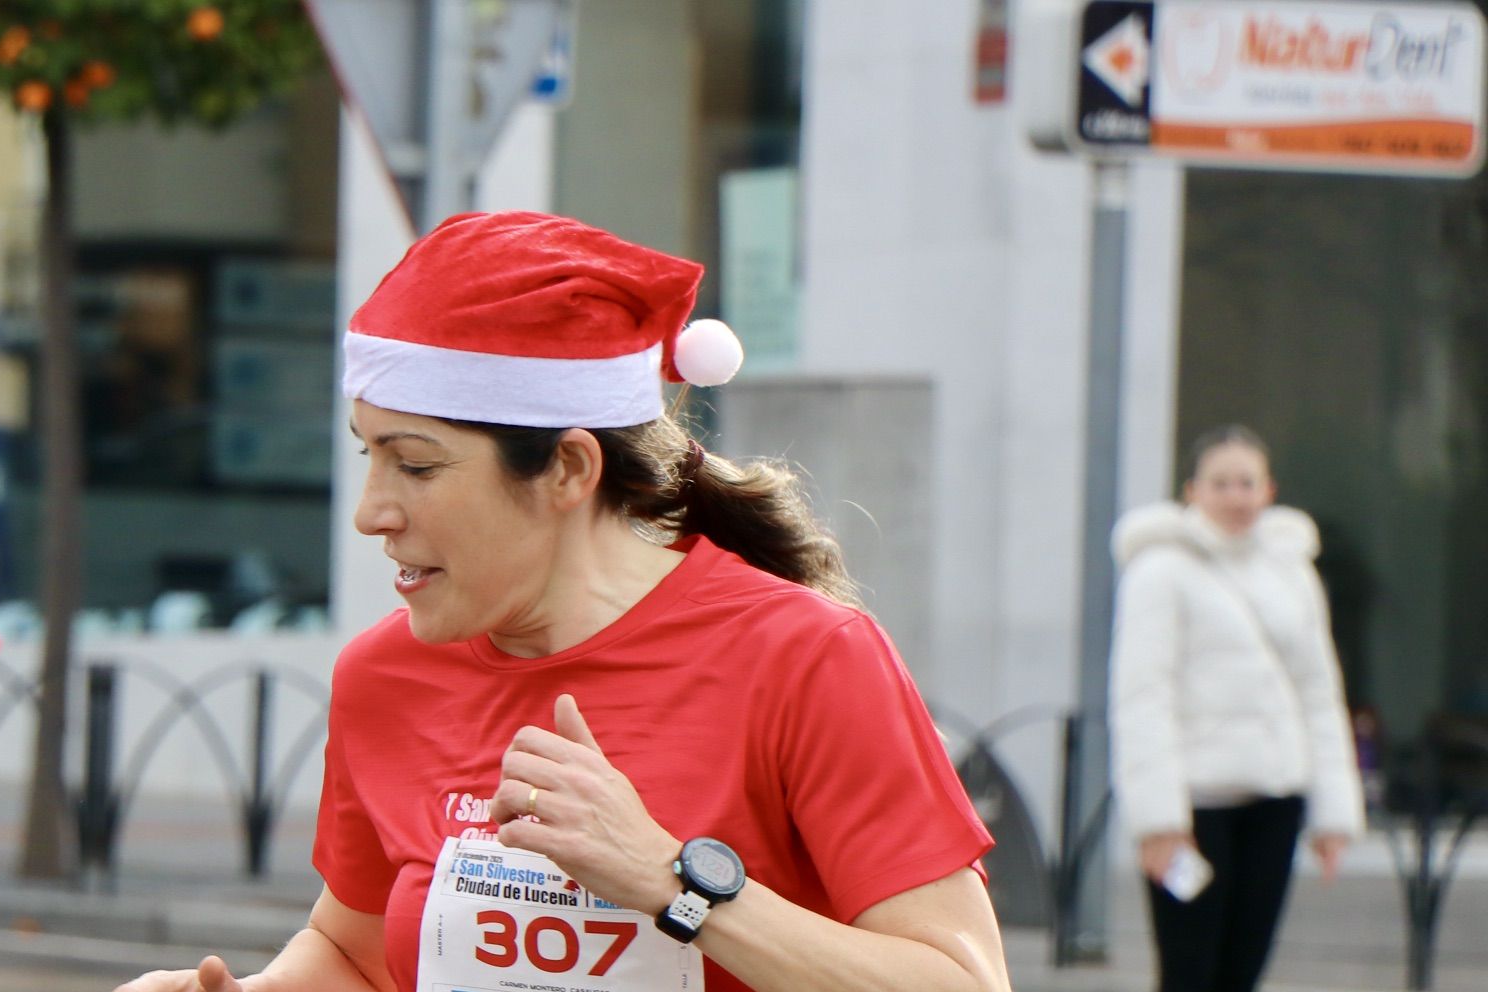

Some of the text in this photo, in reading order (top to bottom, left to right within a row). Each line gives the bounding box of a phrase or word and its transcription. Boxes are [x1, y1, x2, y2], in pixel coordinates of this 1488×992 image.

[459, 859, 484, 877] San
[486, 863, 546, 886] Silvestre
[455, 876, 501, 899] Ciudad
[503, 884, 522, 900] de
[524, 886, 579, 907] Lucena
[475, 910, 639, 977] 307
[499, 980, 528, 989] CARMEN
[530, 984, 567, 992] MONTERO
